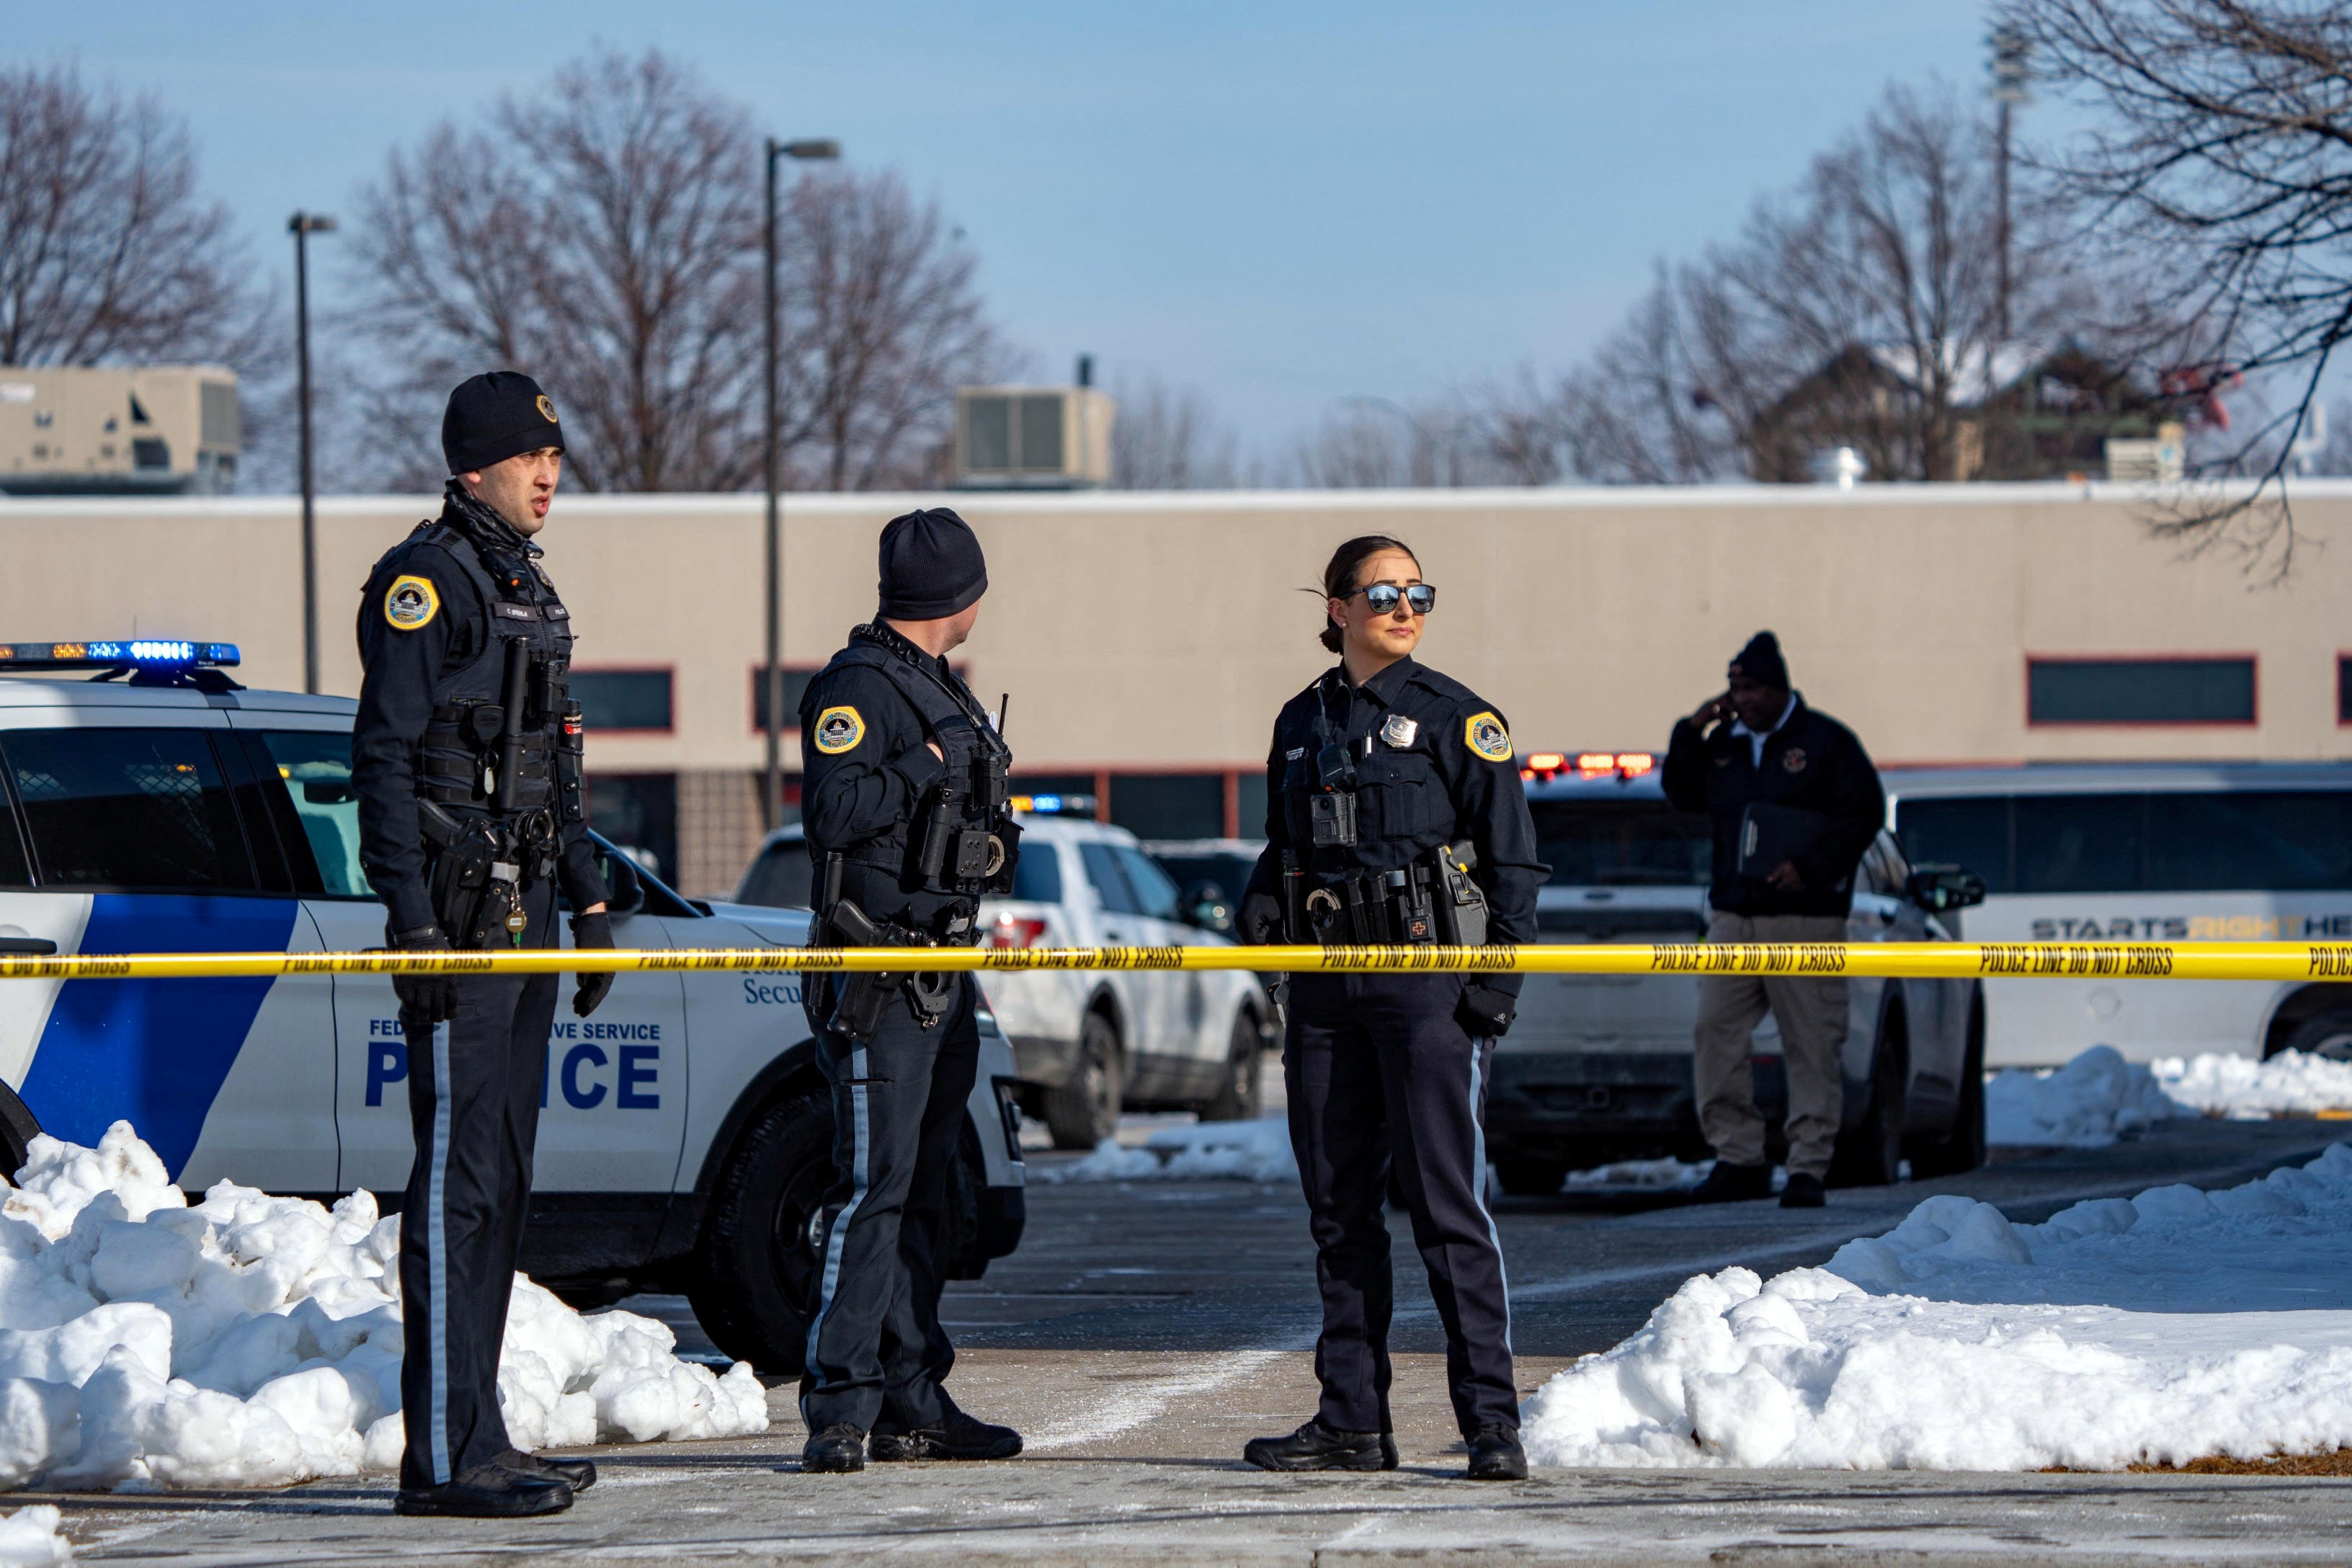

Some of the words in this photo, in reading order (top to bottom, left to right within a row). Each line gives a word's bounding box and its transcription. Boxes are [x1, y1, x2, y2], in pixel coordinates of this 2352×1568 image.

[1321, 945, 1373, 969] POLICE
[1374, 945, 1409, 969] LINE
[1410, 945, 1432, 969] DO
[1434, 945, 1464, 969] NOT
[1468, 945, 1517, 969] CROSS
[1651, 945, 1704, 971] POLICE
[1704, 945, 1739, 971] LINE
[1740, 945, 1764, 971] DO
[1765, 945, 1795, 972] NOT
[1797, 945, 1847, 972] CROSS
[1979, 945, 2031, 973] POLICE
[2033, 945, 2067, 974] LINE
[2068, 946, 2090, 974] DO
[2091, 946, 2121, 974] NOT
[2125, 947, 2174, 975] CROSS
[2307, 946, 2352, 976] POLIC
[582, 1023, 661, 1041] SERVICE
[365, 1042, 660, 1110] PCE
